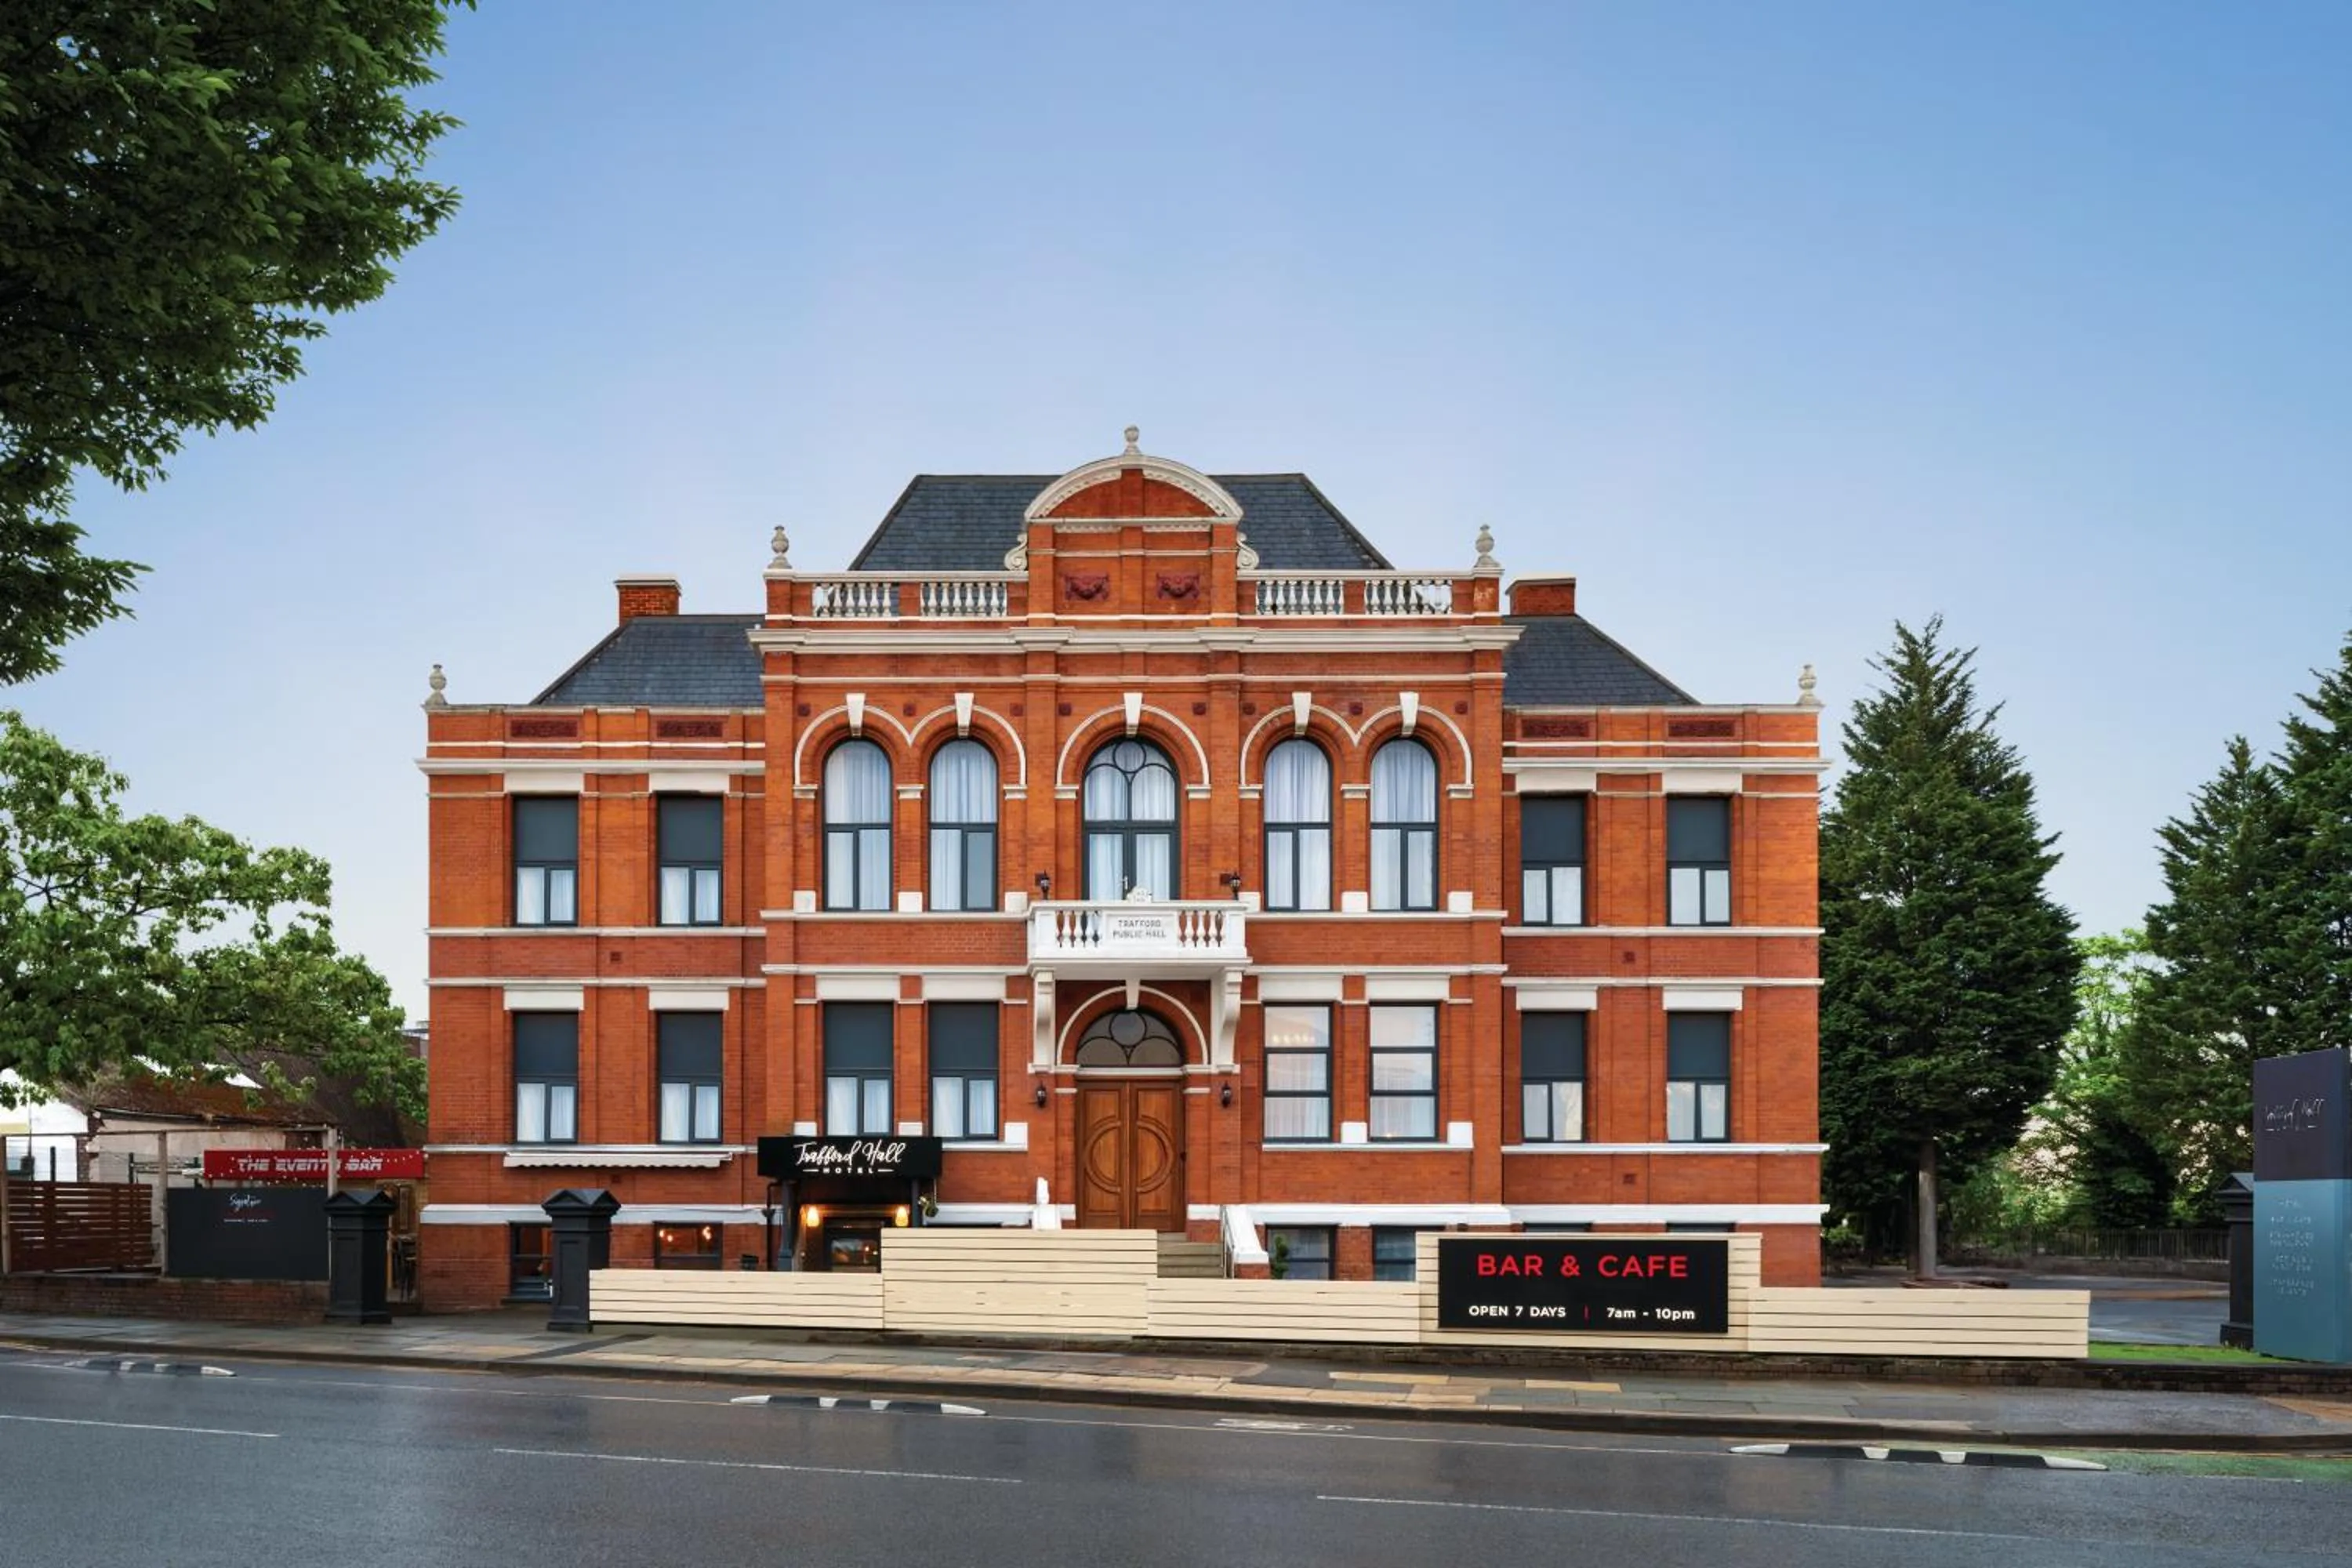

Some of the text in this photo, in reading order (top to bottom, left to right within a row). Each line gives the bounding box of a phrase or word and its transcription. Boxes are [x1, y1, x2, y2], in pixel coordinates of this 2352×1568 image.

[1118, 919, 1161, 927] TRAFFORD
[1112, 930, 1142, 938] PUBLIC
[793, 1139, 906, 1167] Trafford Hall
[237, 1158, 270, 1172] THE
[345, 1156, 383, 1171] BAR
[1477, 1254, 1688, 1277] BAR & CAFE
[1468, 1305, 1566, 1317] OPEN 7 DAYS
[1607, 1308, 1636, 1319] 7am
[1656, 1308, 1695, 1320] 10pm
